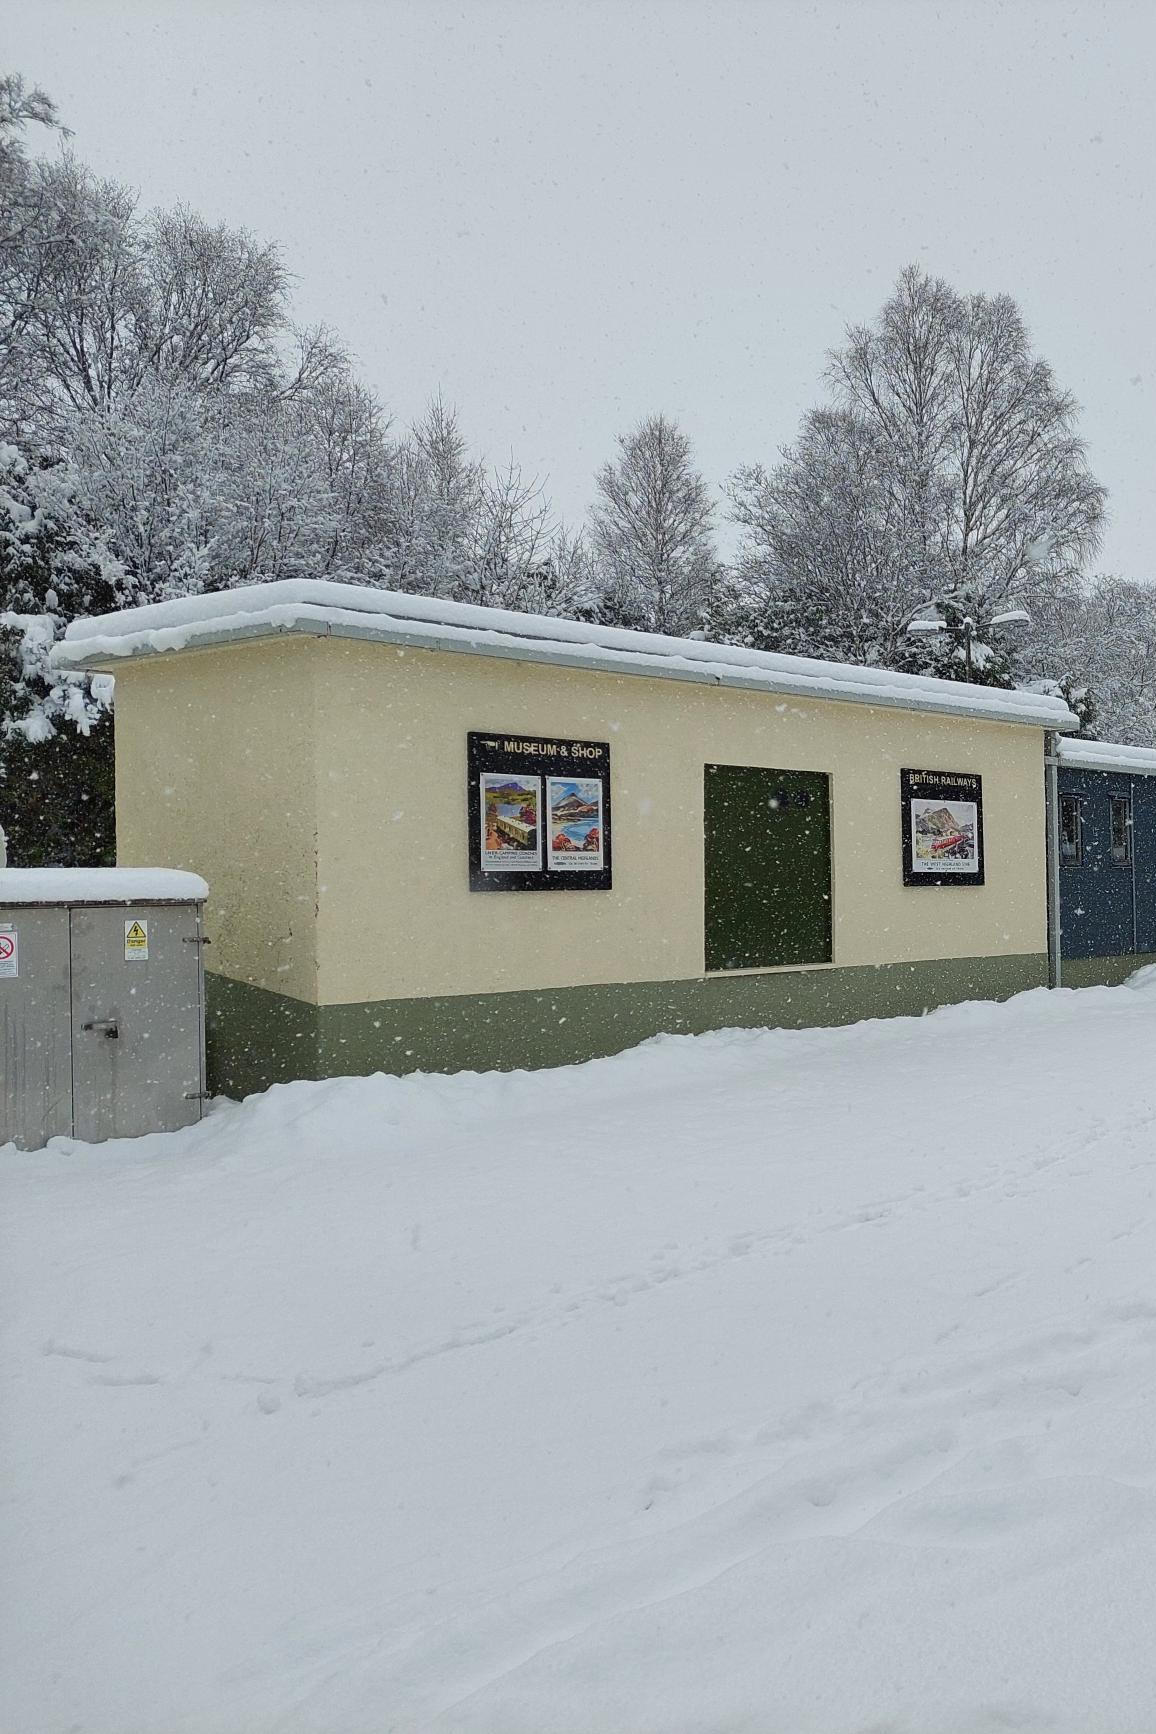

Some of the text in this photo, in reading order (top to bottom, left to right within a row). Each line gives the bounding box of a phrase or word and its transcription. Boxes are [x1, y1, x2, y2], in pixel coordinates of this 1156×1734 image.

[504, 741, 602, 759] MUSEUM & SHOP
[909, 773, 977, 787] BRITISH RAILWAYS
